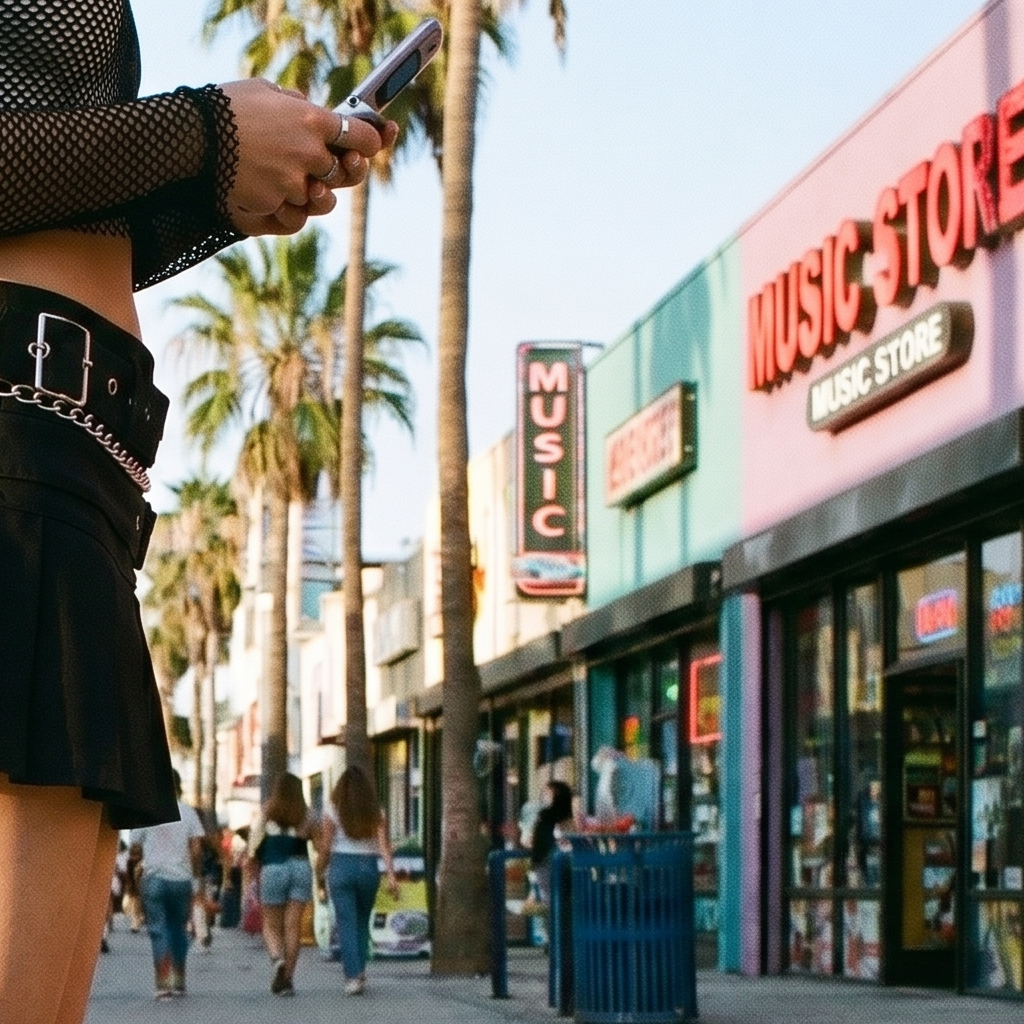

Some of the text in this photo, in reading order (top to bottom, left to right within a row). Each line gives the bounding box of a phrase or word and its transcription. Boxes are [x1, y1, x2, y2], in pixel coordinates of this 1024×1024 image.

[748, 78, 1024, 391] MUSIC STORE
[528, 360, 569, 538] MUSIC
[811, 312, 943, 422] MUSIC STORE
